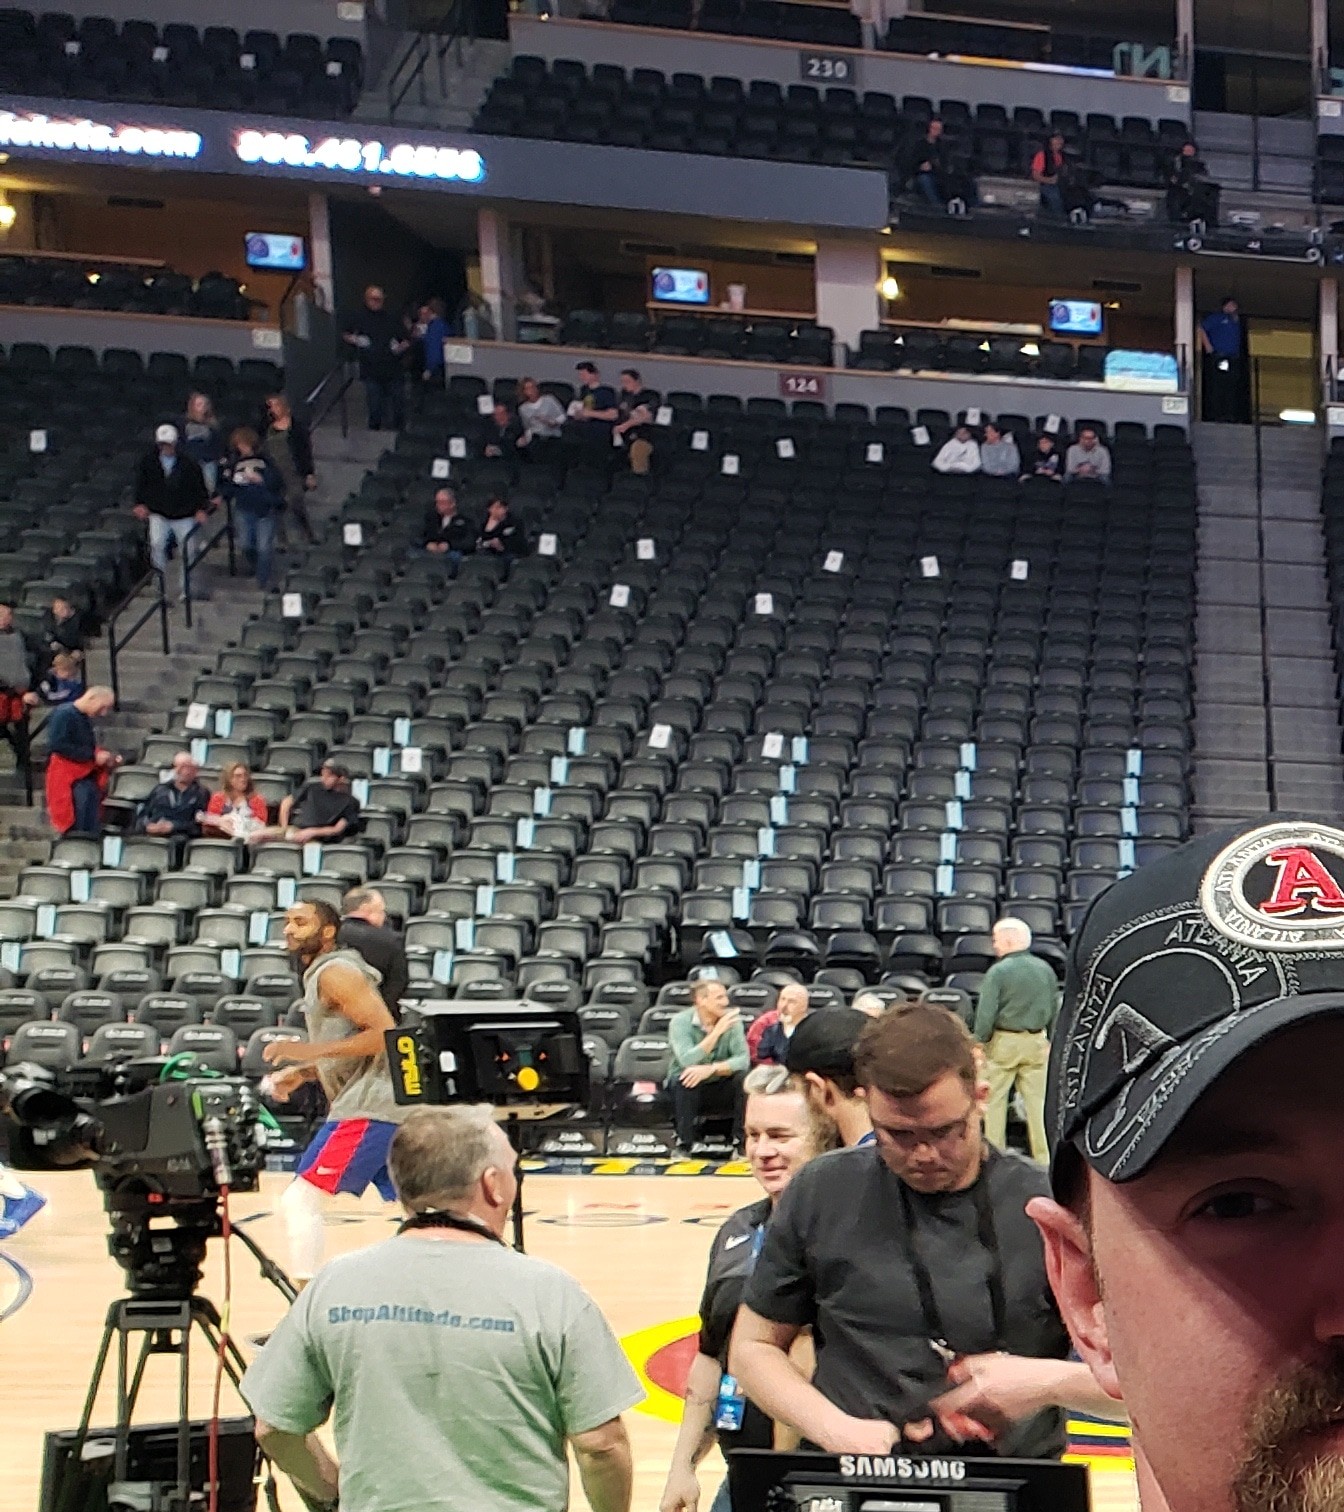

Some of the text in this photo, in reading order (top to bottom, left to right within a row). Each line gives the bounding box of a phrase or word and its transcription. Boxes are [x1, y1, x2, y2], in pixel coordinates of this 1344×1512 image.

[807, 58, 848, 78] 230
[785, 377, 818, 393] 124
[328, 1304, 515, 1333] ShopAltitude.com
[839, 1454, 967, 1482] SAMSUNG
